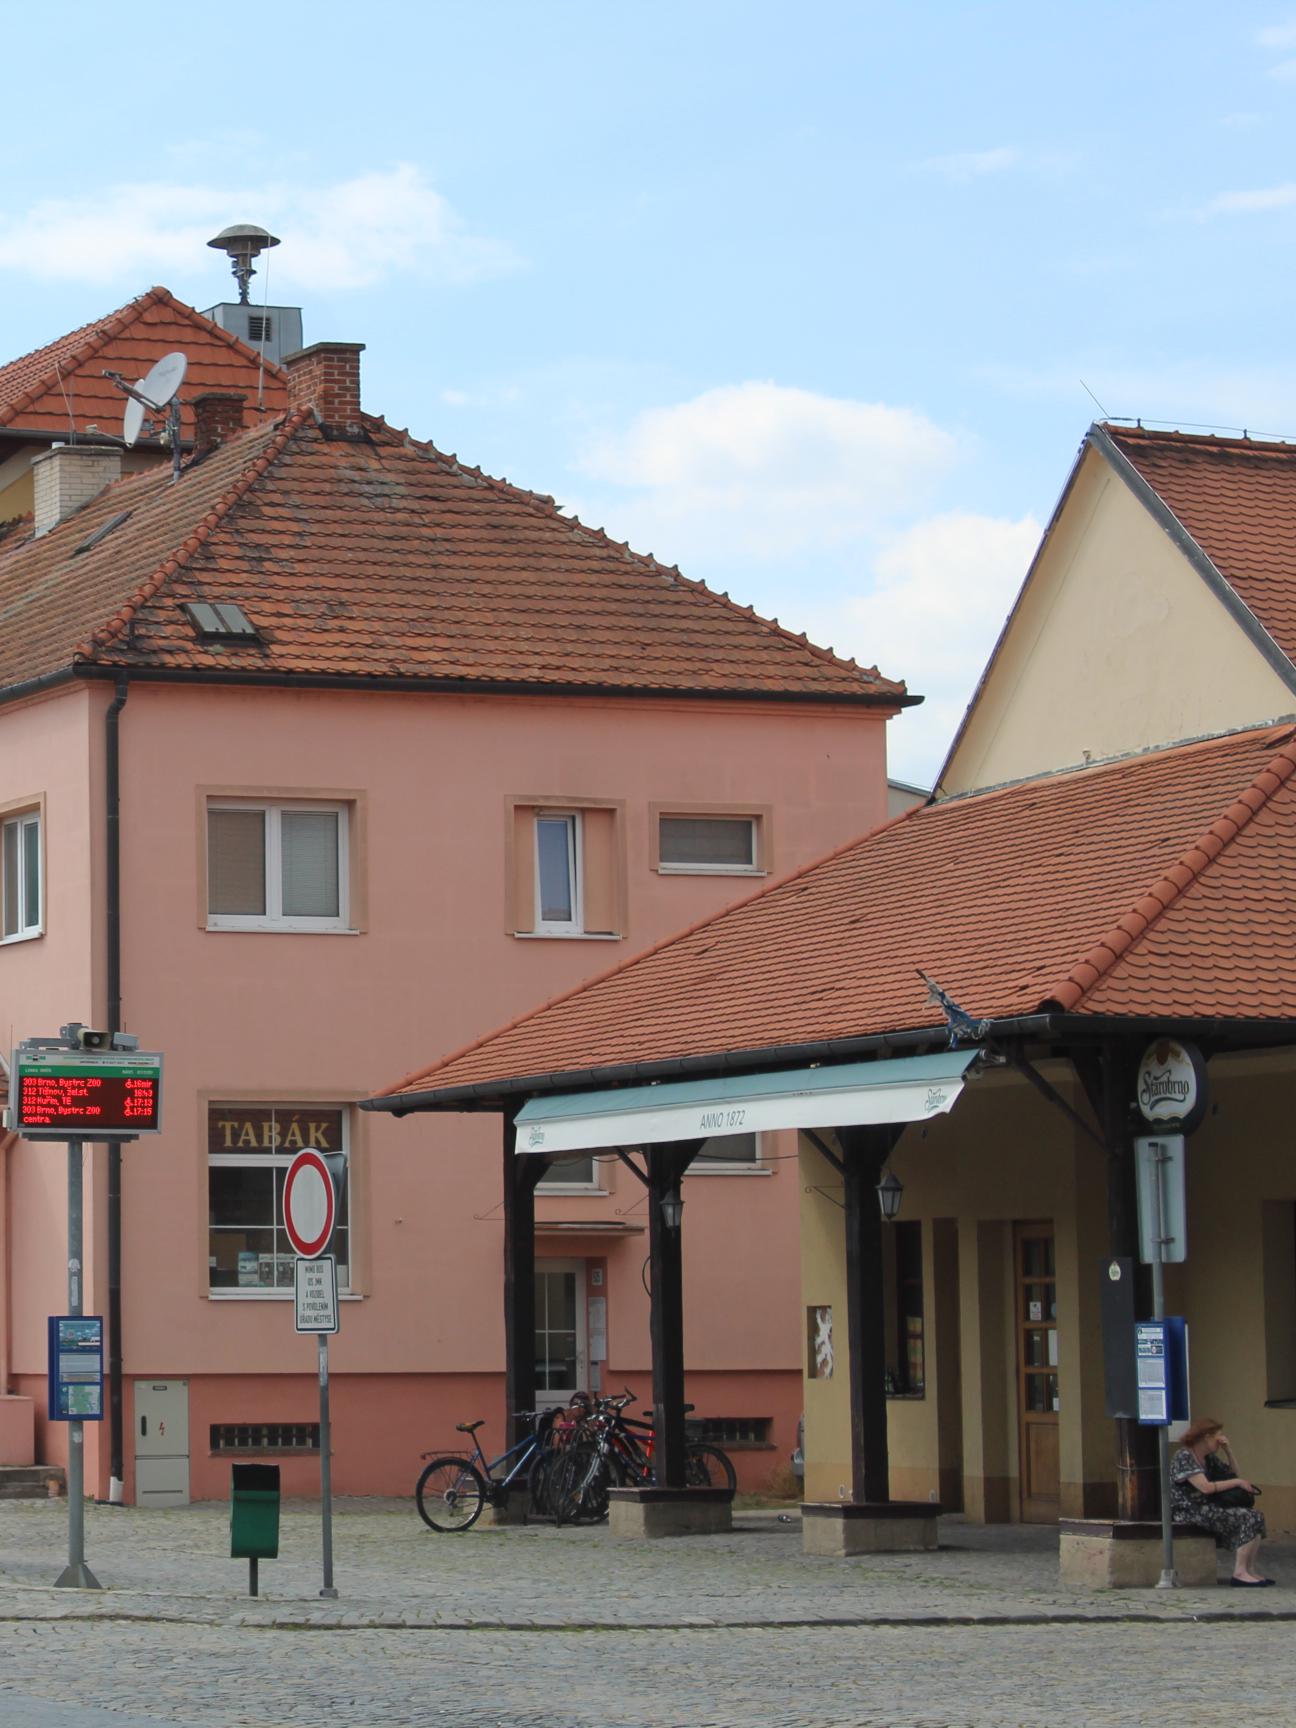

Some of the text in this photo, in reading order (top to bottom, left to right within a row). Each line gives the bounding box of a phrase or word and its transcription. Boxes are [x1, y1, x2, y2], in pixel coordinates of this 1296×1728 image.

[23, 1078, 37, 1086] 303
[37, 1078, 57, 1087] Brno,
[59, 1078, 85, 1087] Bystrc
[23, 1087, 37, 1095] 312
[23, 1097, 36, 1105] 312
[22, 1106, 36, 1114] 303
[36, 1106, 56, 1115] Brno,
[58, 1106, 84, 1115] Bystrc
[134, 1107, 152, 1116] 17:15
[700, 1110, 745, 1129] ANNO 1872
[218, 1115, 331, 1148] TABÁK
